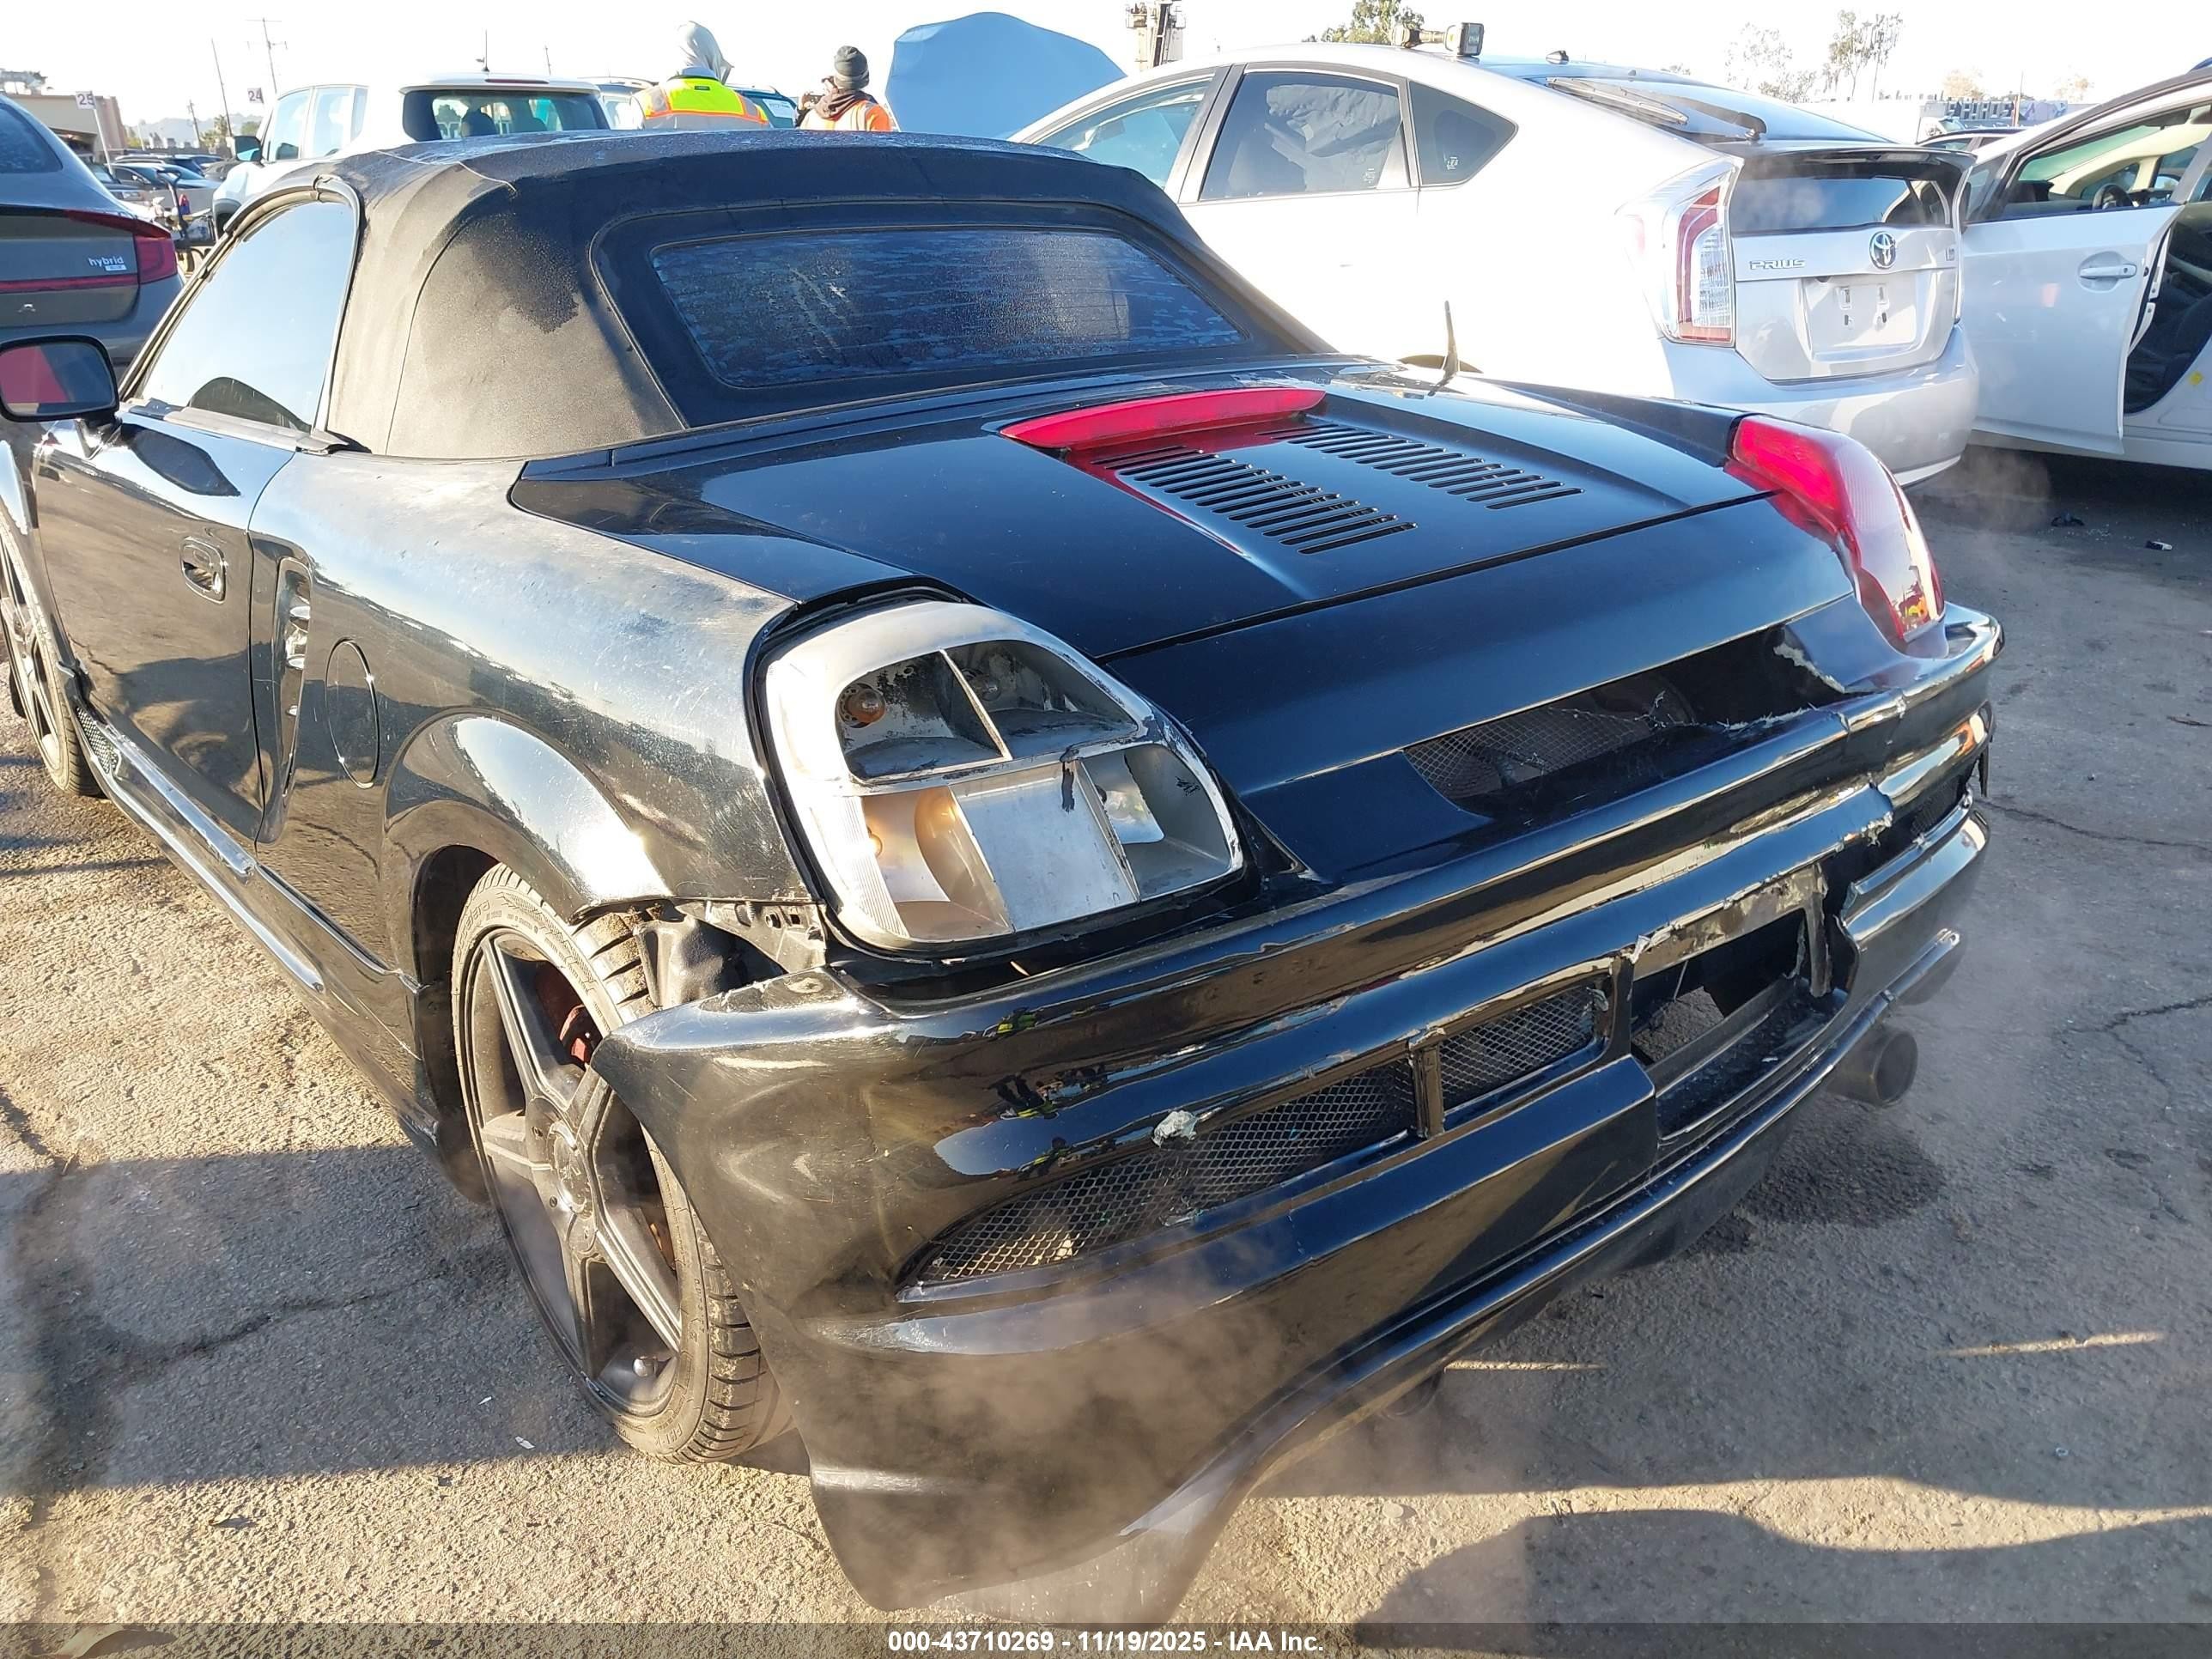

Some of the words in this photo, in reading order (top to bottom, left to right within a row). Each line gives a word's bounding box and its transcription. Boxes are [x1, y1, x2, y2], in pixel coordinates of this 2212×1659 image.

[77, 94, 94, 106] 25
[248, 90, 262, 101] 24
[88, 256, 125, 267] hybrid
[1749, 259, 1806, 270] PRIUS
